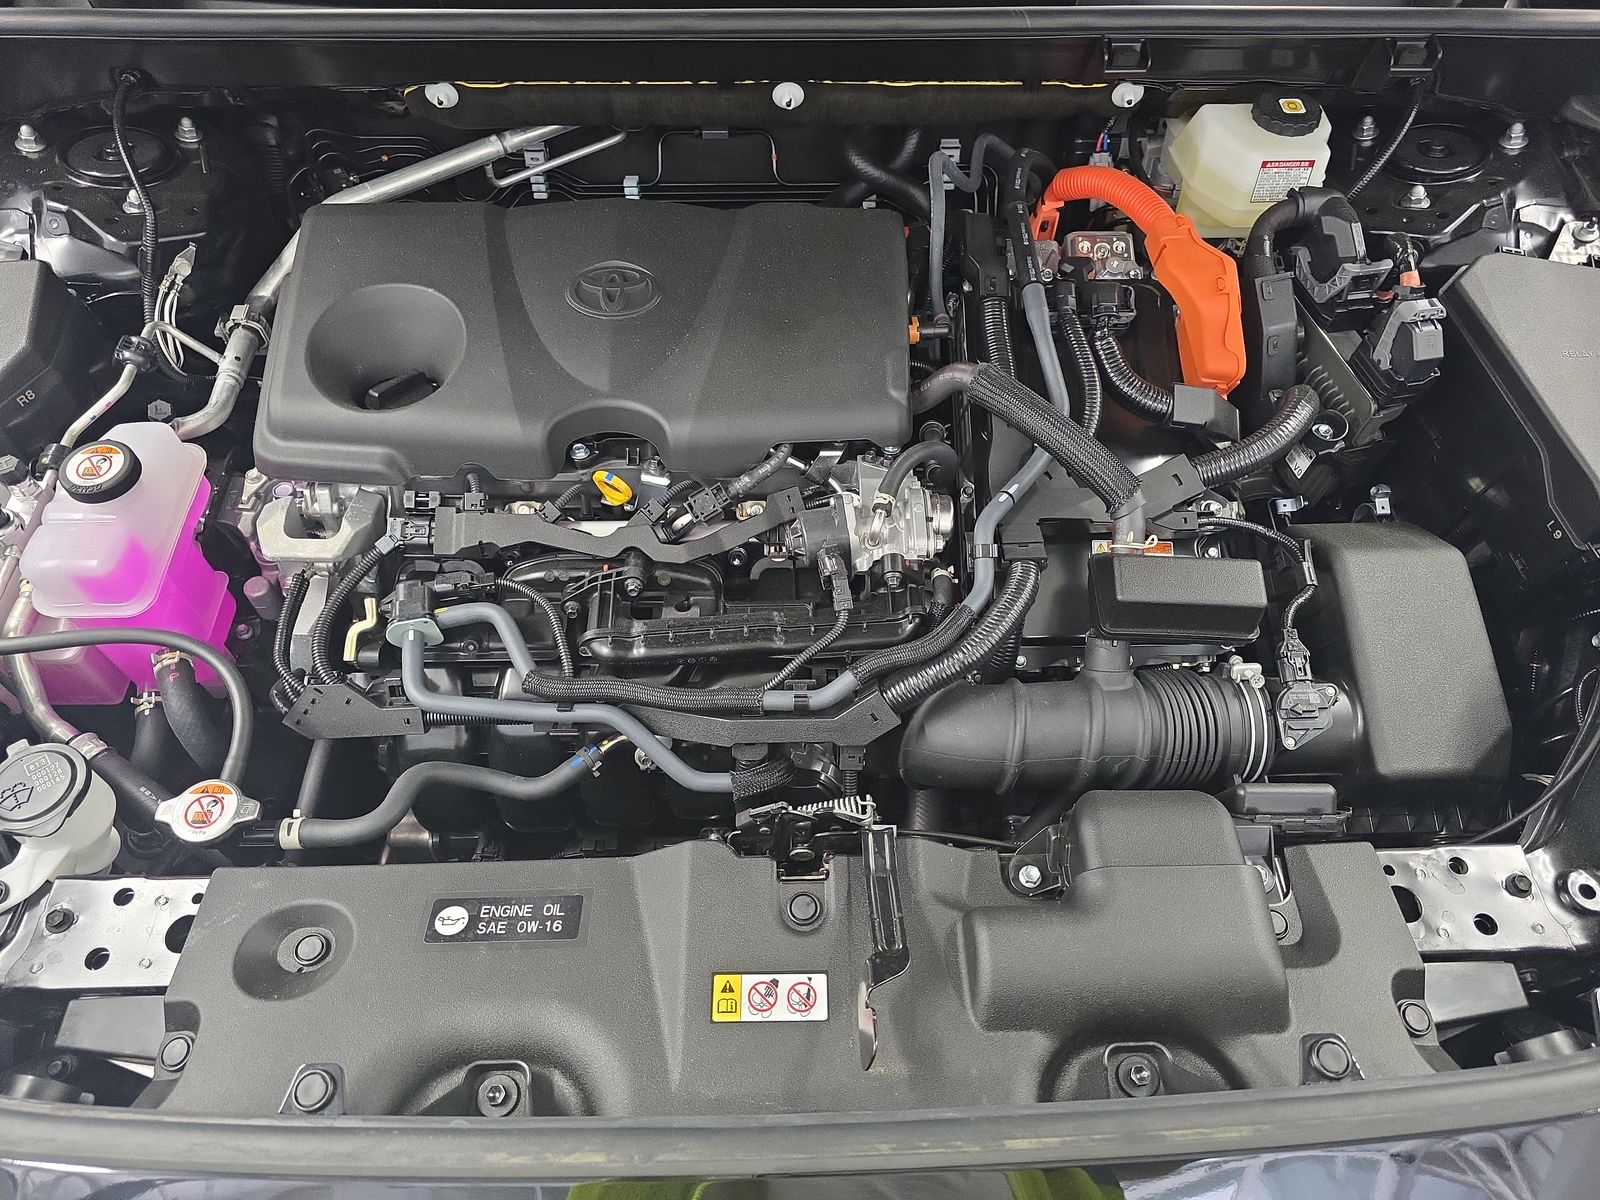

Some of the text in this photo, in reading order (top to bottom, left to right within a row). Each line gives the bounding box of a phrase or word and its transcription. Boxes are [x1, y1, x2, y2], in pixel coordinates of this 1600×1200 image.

[1561, 349, 1594, 359] RELAY
[16, 389, 36, 407] R8
[69, 483, 103, 493] DENSO
[1546, 520, 1562, 540] L9
[29, 758, 46, 771] e13
[32, 761, 60, 780] 000127
[480, 903, 565, 918] ENGINE OIL
[476, 919, 562, 935] SAE 0W-16
